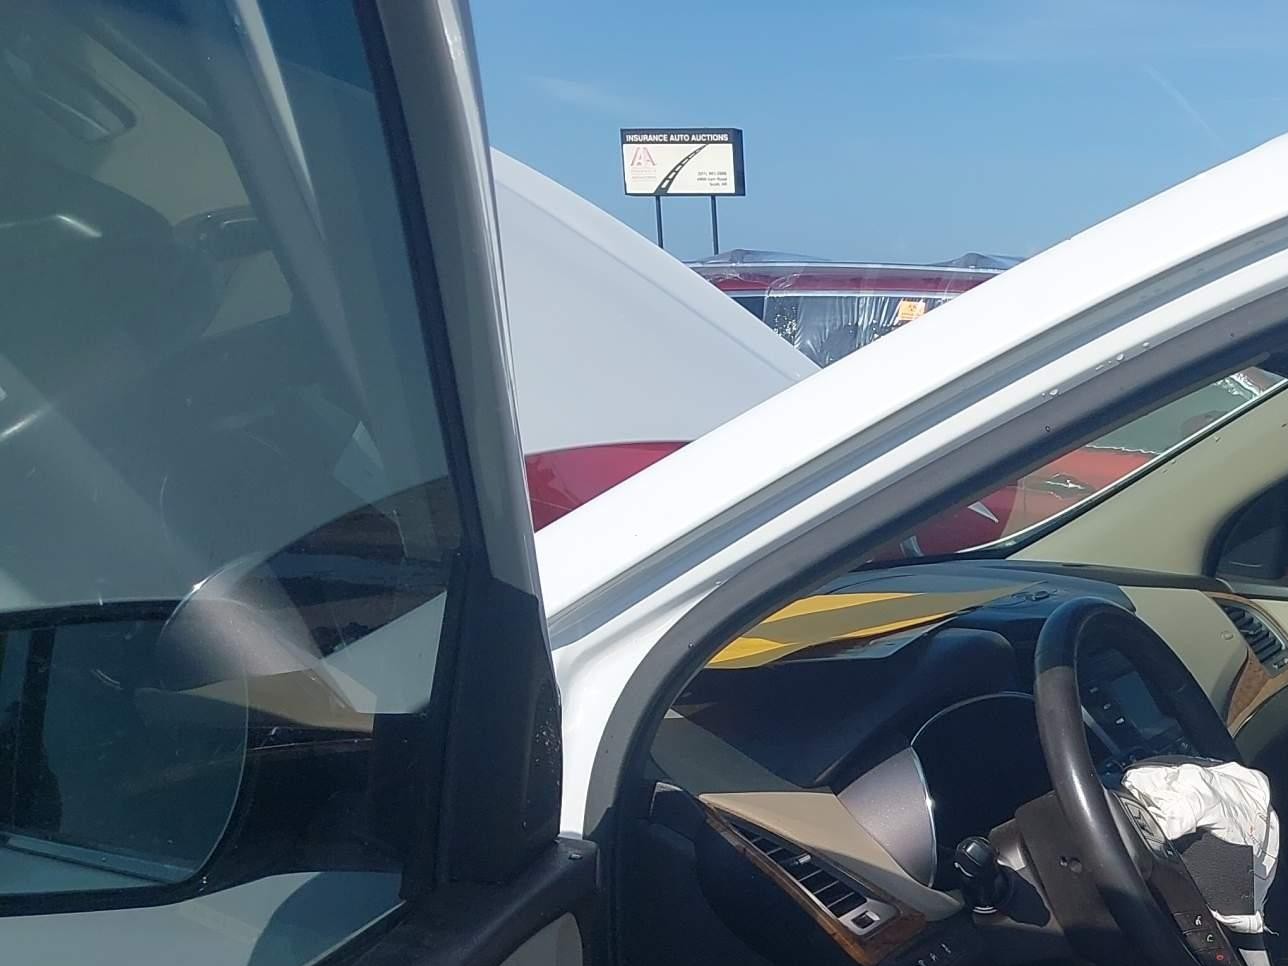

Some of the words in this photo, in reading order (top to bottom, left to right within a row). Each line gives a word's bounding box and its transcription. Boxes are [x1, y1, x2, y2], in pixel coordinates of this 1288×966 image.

[626, 134, 668, 142] INSURANCE
[669, 134, 689, 142] AUTO
[691, 134, 729, 142] AUCTIONS
